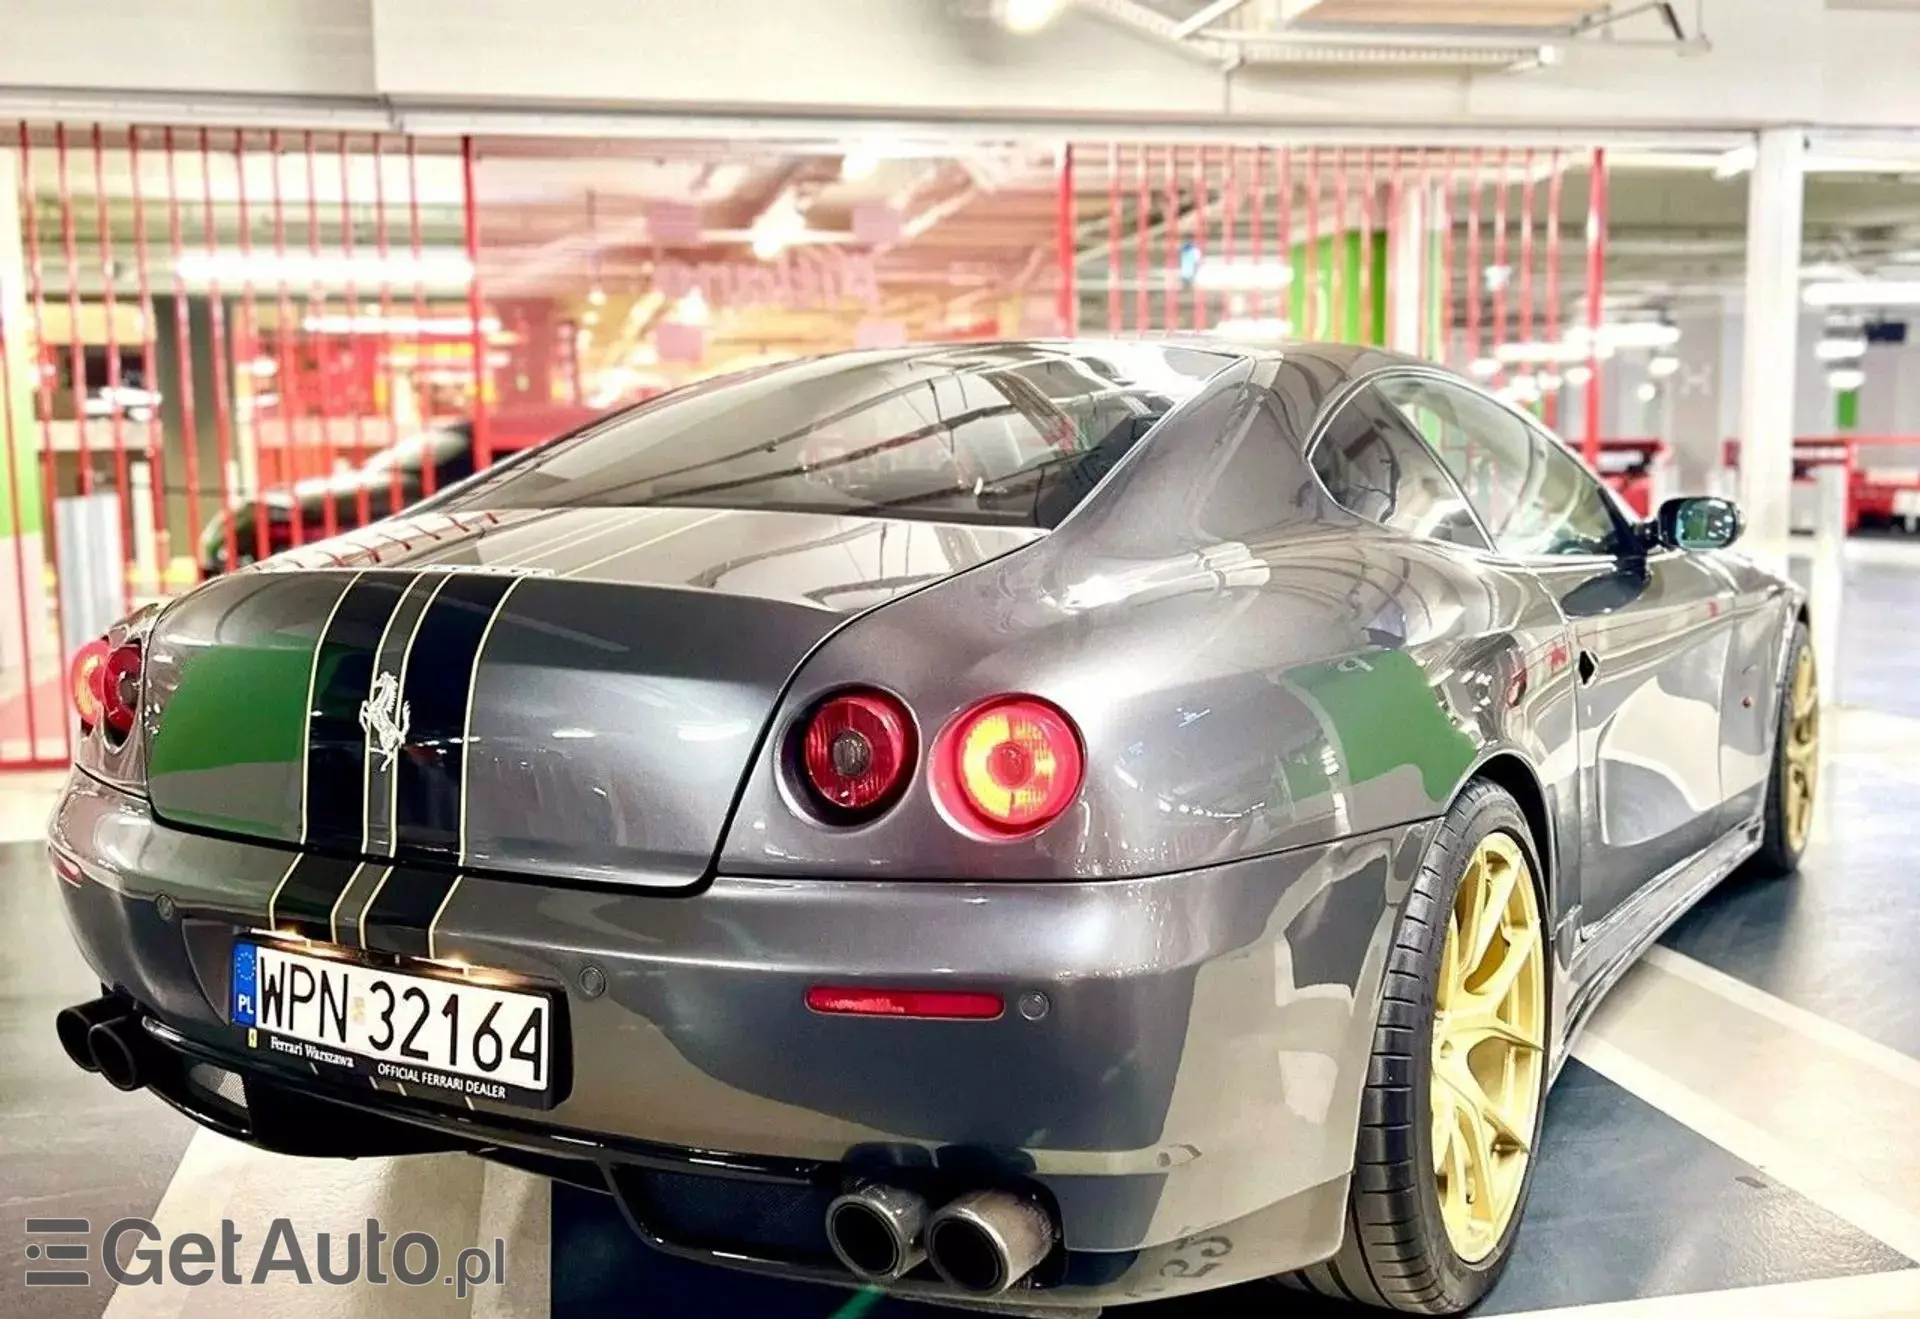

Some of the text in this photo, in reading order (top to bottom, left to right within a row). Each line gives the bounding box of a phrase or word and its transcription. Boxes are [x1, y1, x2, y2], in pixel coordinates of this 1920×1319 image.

[238, 993, 254, 1015] PL
[260, 957, 543, 1082] WPN 32164
[270, 1035, 355, 1068] Ferrari Warszawa
[377, 1062, 506, 1099] OFFICIAL FERRARI DEALER
